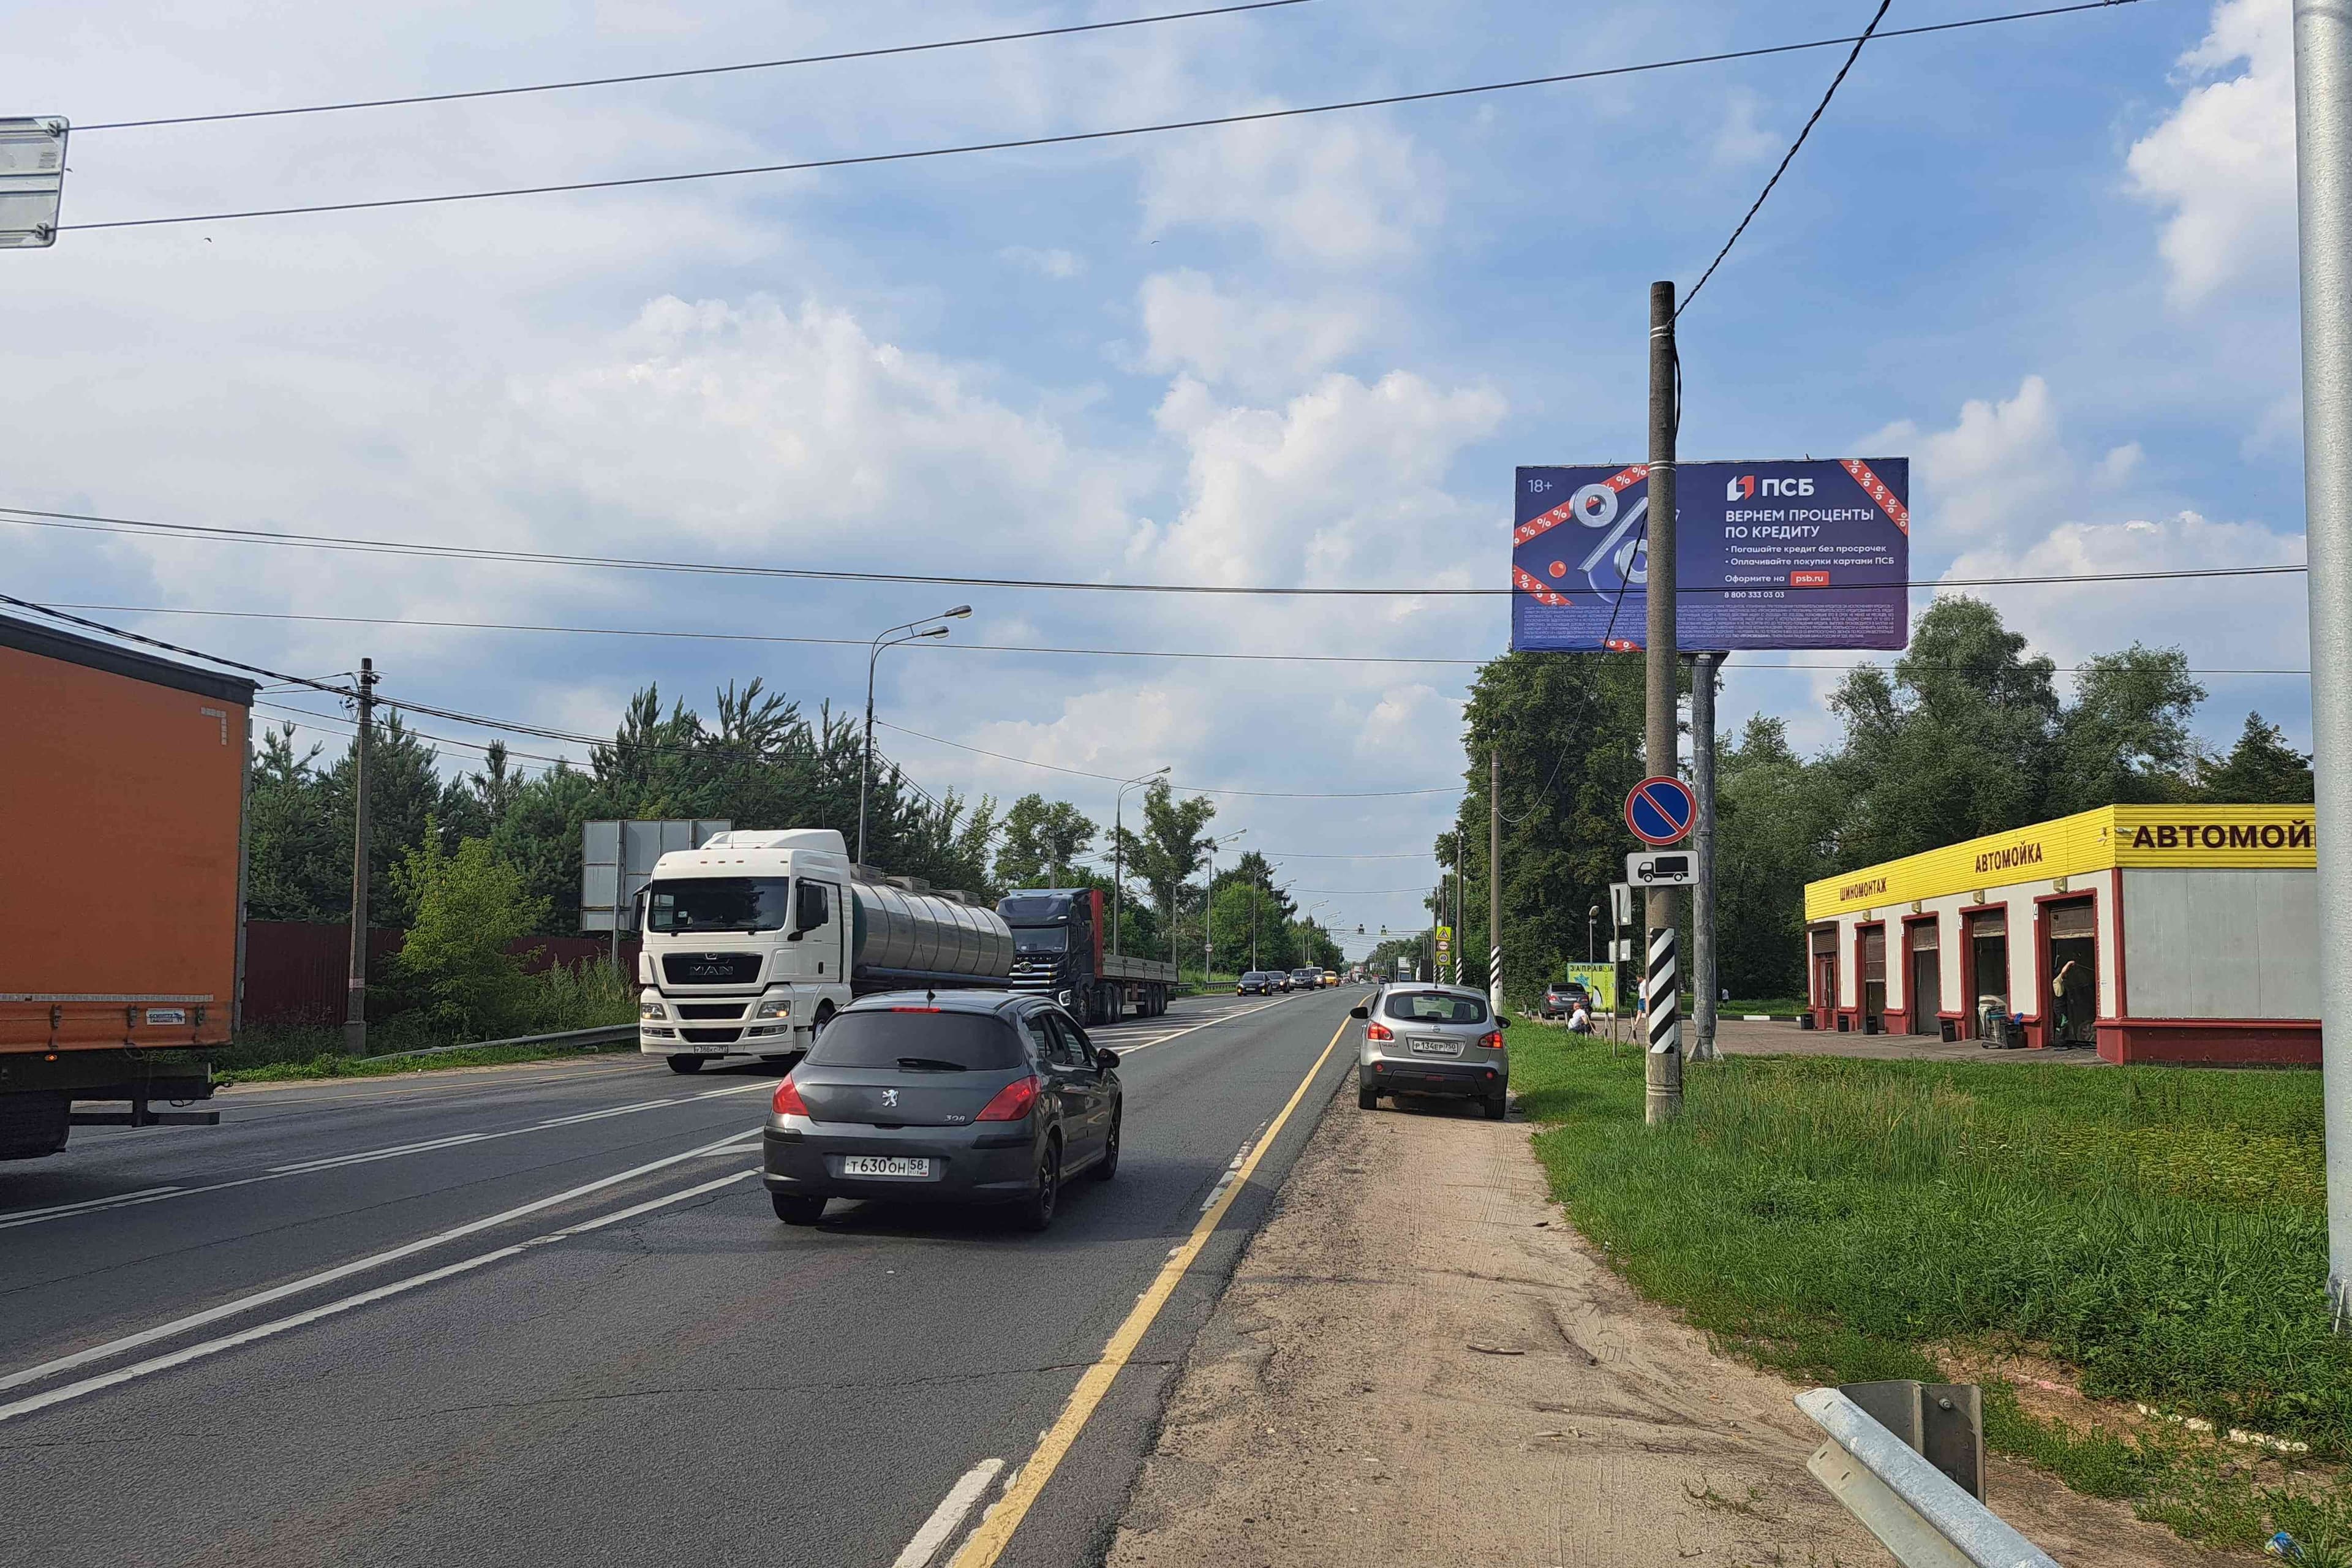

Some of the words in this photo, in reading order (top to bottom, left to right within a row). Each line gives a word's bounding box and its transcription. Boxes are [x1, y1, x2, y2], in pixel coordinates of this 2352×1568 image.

[1528, 479, 1553, 492] 18+
[1762, 478, 1815, 497] ПСБ
[1725, 509, 1784, 522] ВЕРНЕМ
[1789, 509, 1874, 522] ПРОЦЕНТЫ
[1725, 526, 1748, 538] ПО
[1752, 526, 1820, 540] КРЕДИТУ
[1731, 545, 1781, 554] Погашайте
[1784, 546, 1816, 554] кредит
[1836, 545, 1887, 554] просрочек
[1730, 557, 1791, 566] Оплачивайте
[1793, 558, 1831, 567] покупки
[1833, 558, 1872, 567] картами
[1725, 575, 1771, 584] Оформите
[1796, 574, 1823, 584] psb.ru
[2132, 819, 2316, 849] АВТОМОЙ
[1975, 840, 2043, 873] АВТОМОЙКА
[1840, 877, 1887, 902] ШИНОМОНТАЖ
[690, 965, 733, 975] MAN
[910, 1159, 923, 1170] 58
